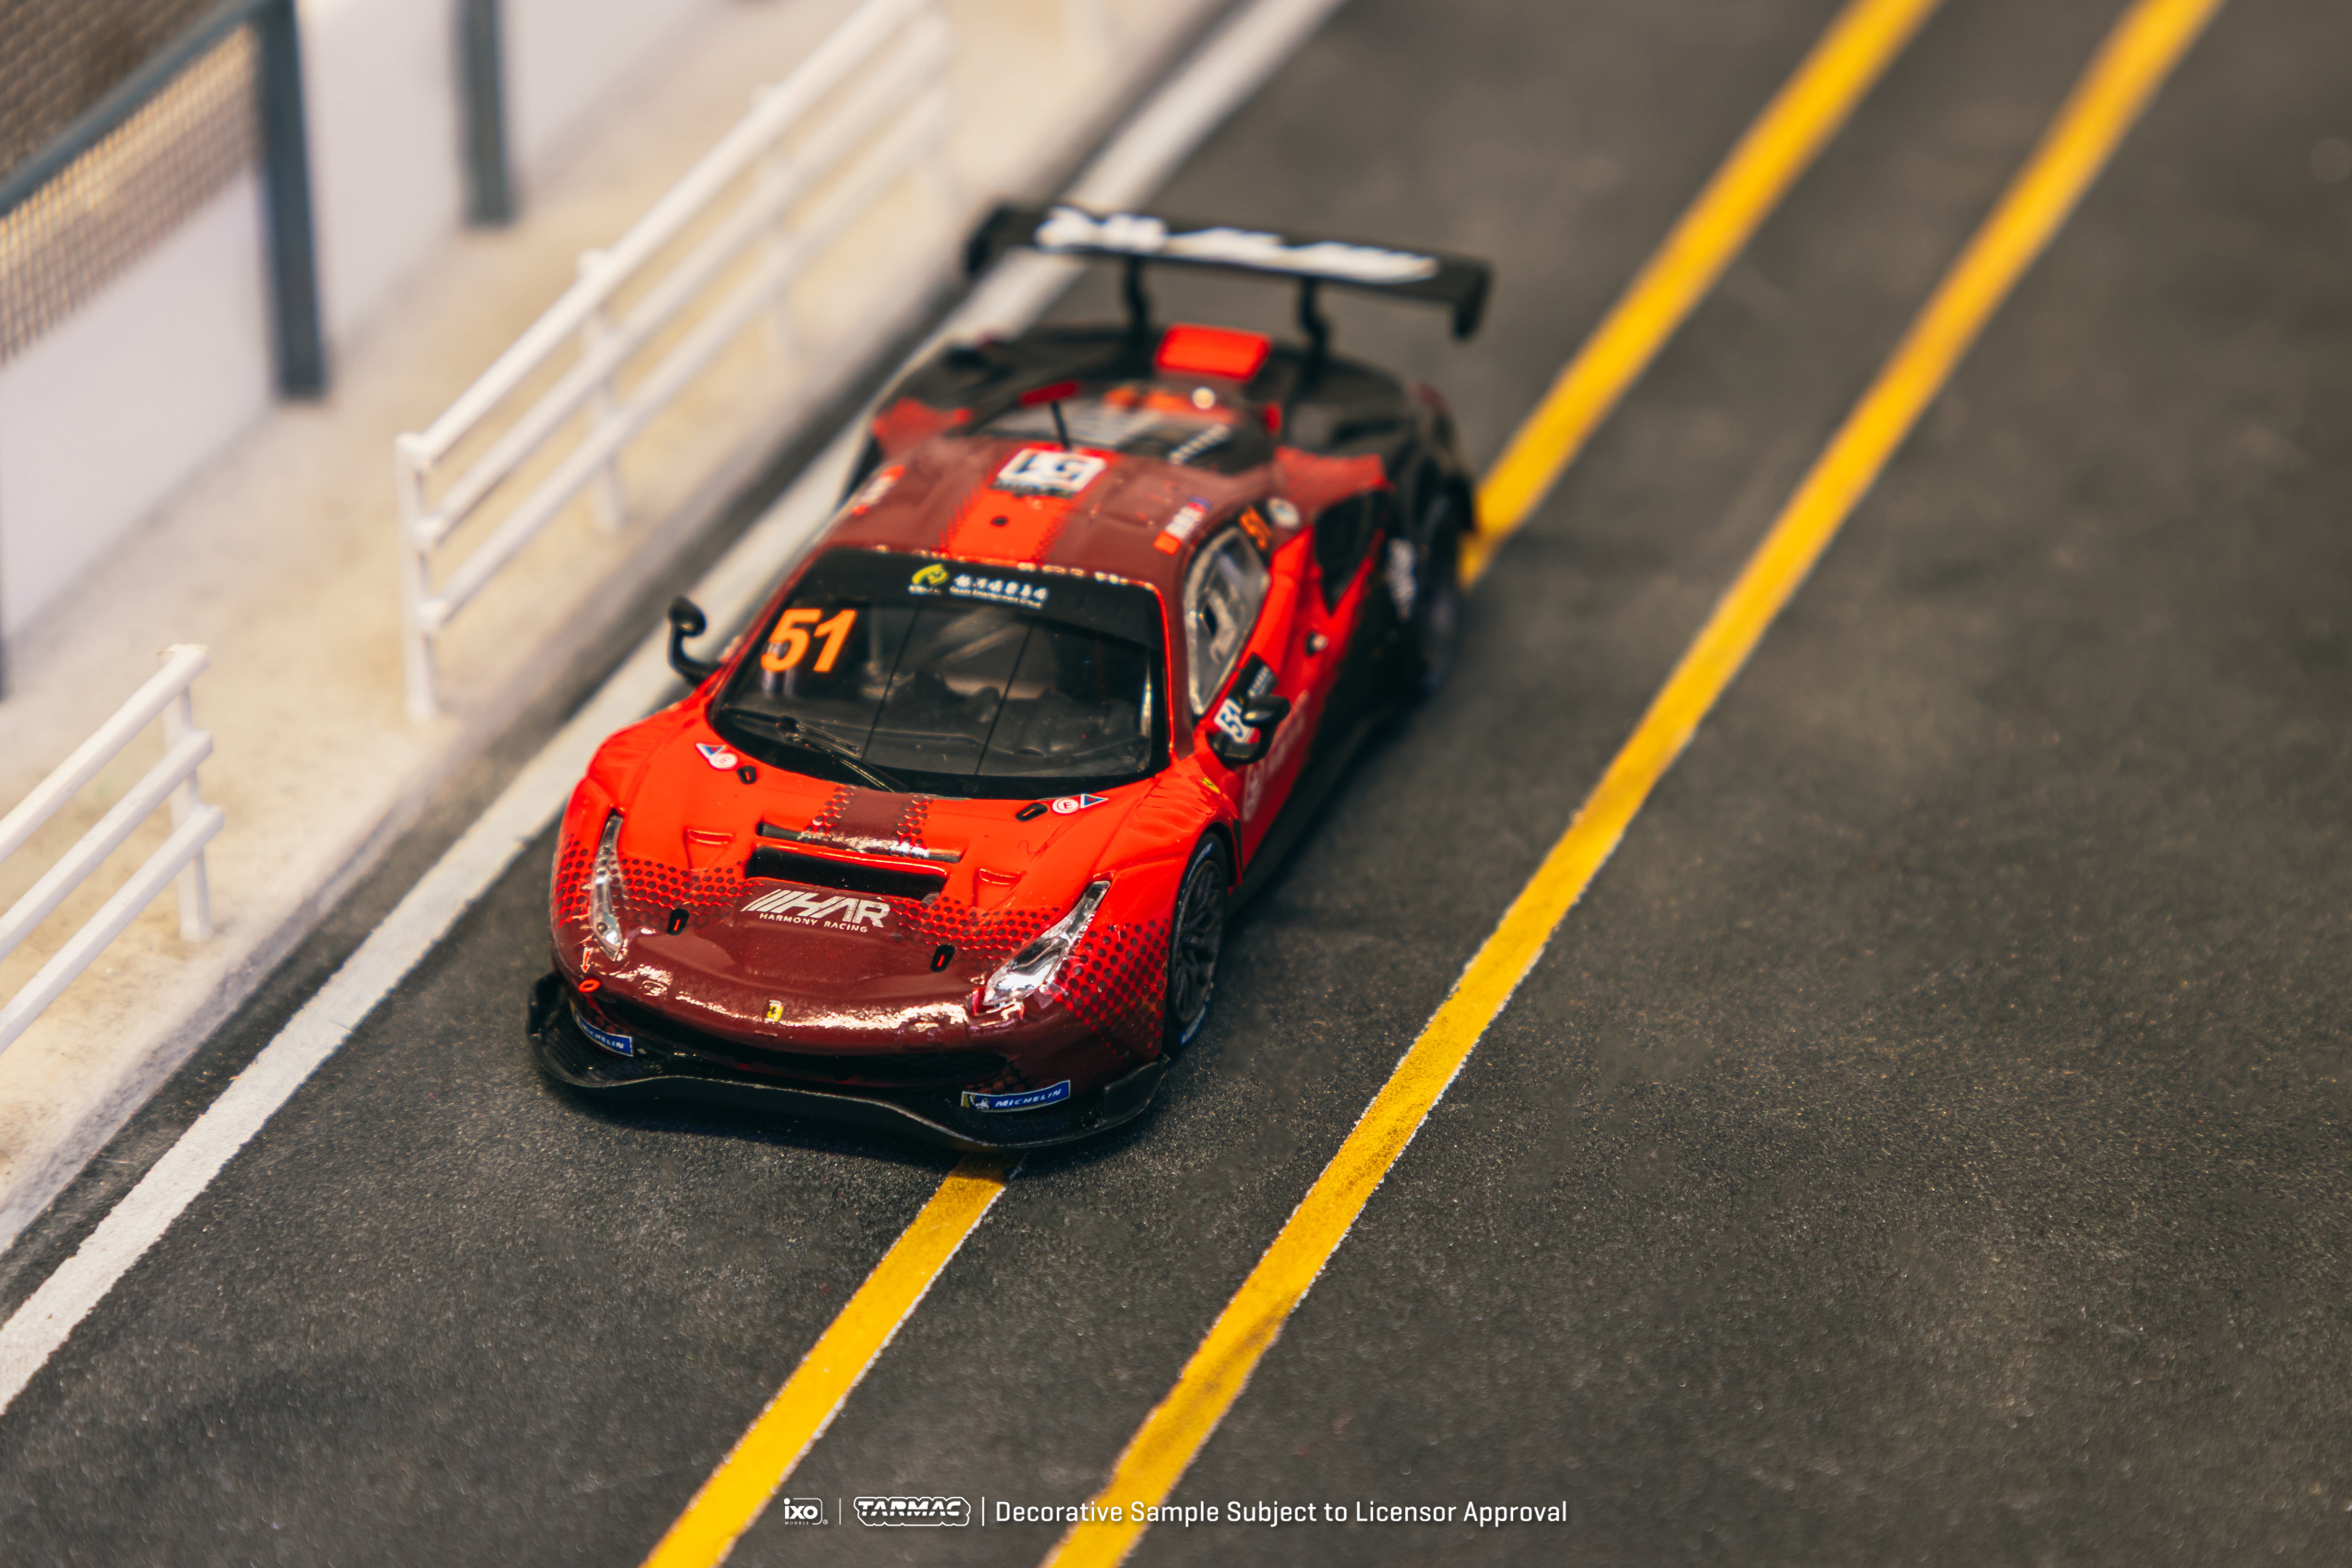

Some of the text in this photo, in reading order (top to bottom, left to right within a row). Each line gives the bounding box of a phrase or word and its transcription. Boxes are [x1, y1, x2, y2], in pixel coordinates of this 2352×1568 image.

[760, 608, 857, 672] 51
[759, 913, 868, 933] HARMONY RACING
[995, 1089, 1061, 1107] MICHELIN
